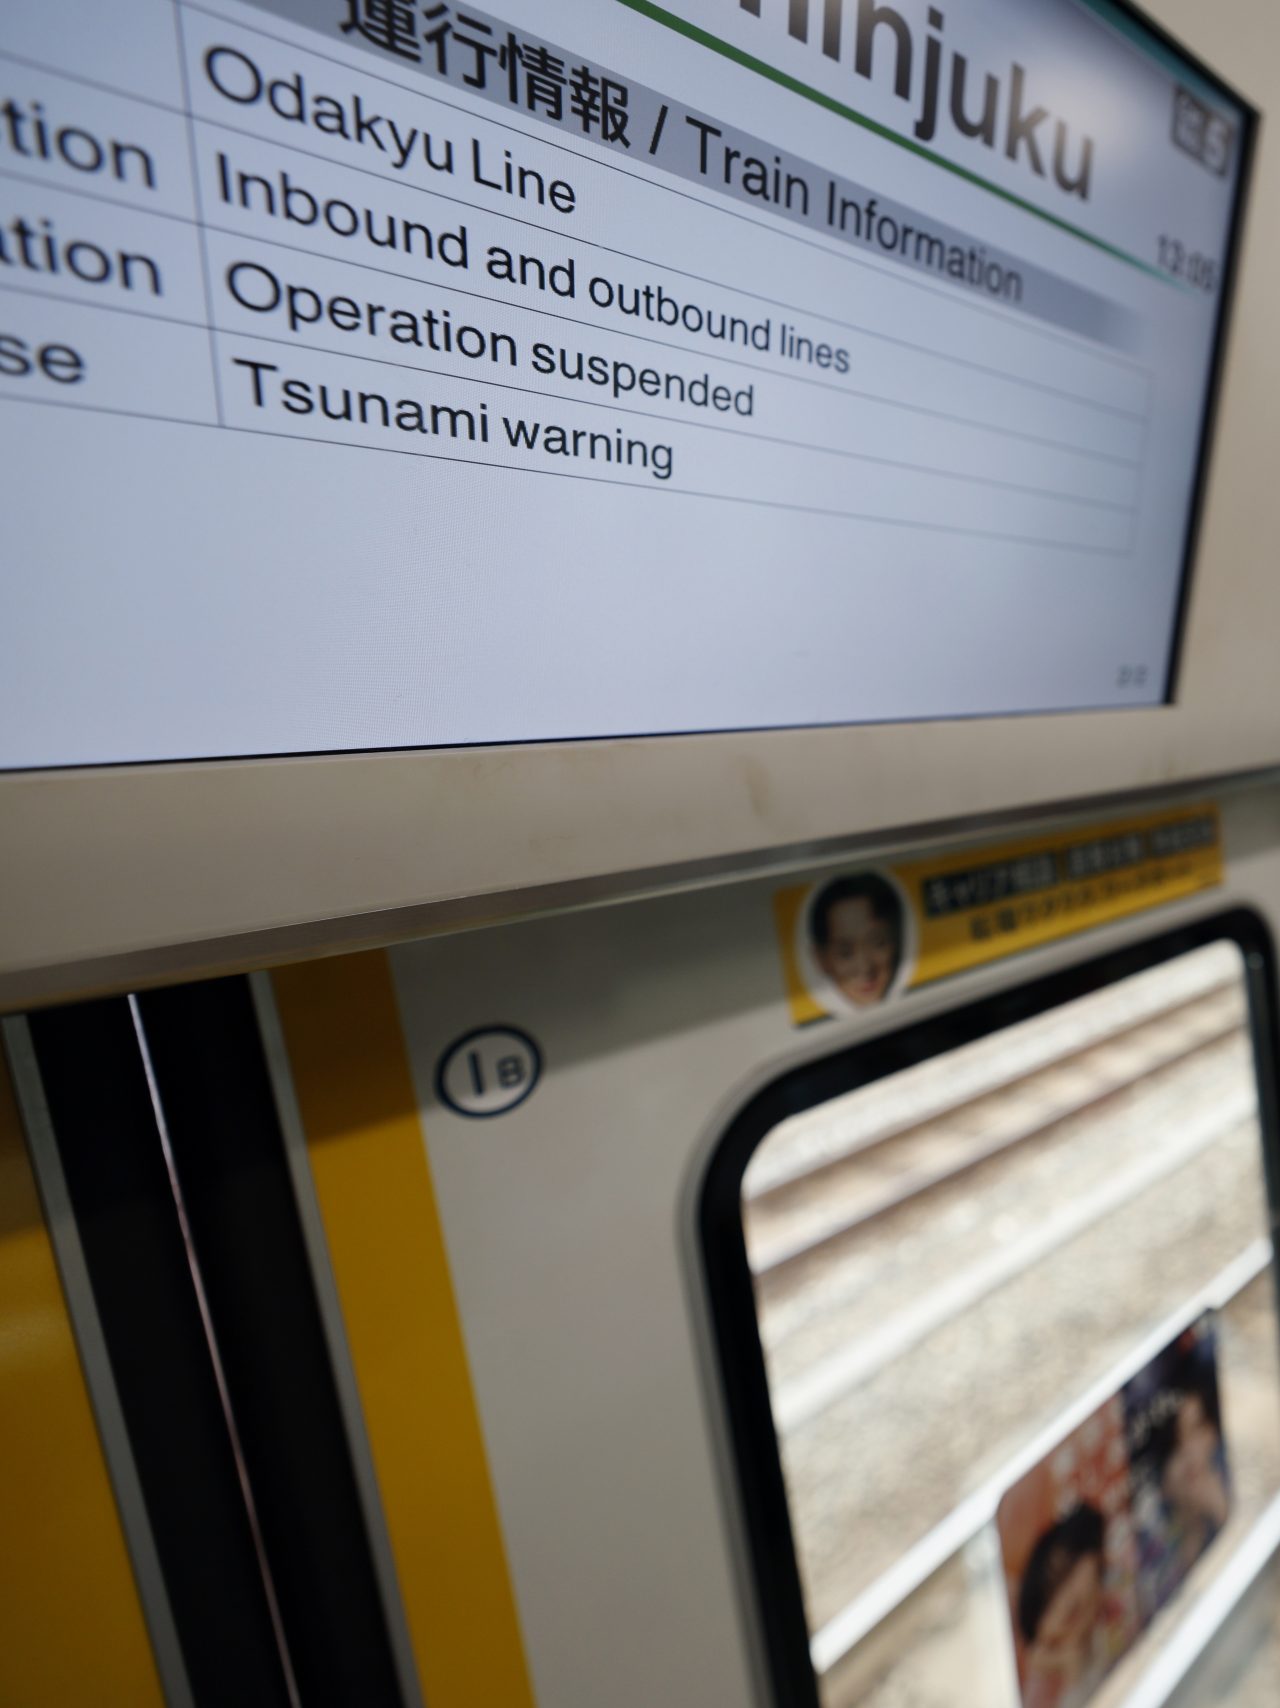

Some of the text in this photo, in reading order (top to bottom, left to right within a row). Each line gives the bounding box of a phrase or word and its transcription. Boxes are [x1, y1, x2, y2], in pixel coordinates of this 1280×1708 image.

[204, 45, 577, 214] Odakyu Line
[338, 0, 1024, 302] 運行情報 / Train Information
[216, 152, 852, 375] Inbound and outbound lines
[226, 260, 754, 417] Operation suspended
[232, 357, 674, 480] Tsunami warning
